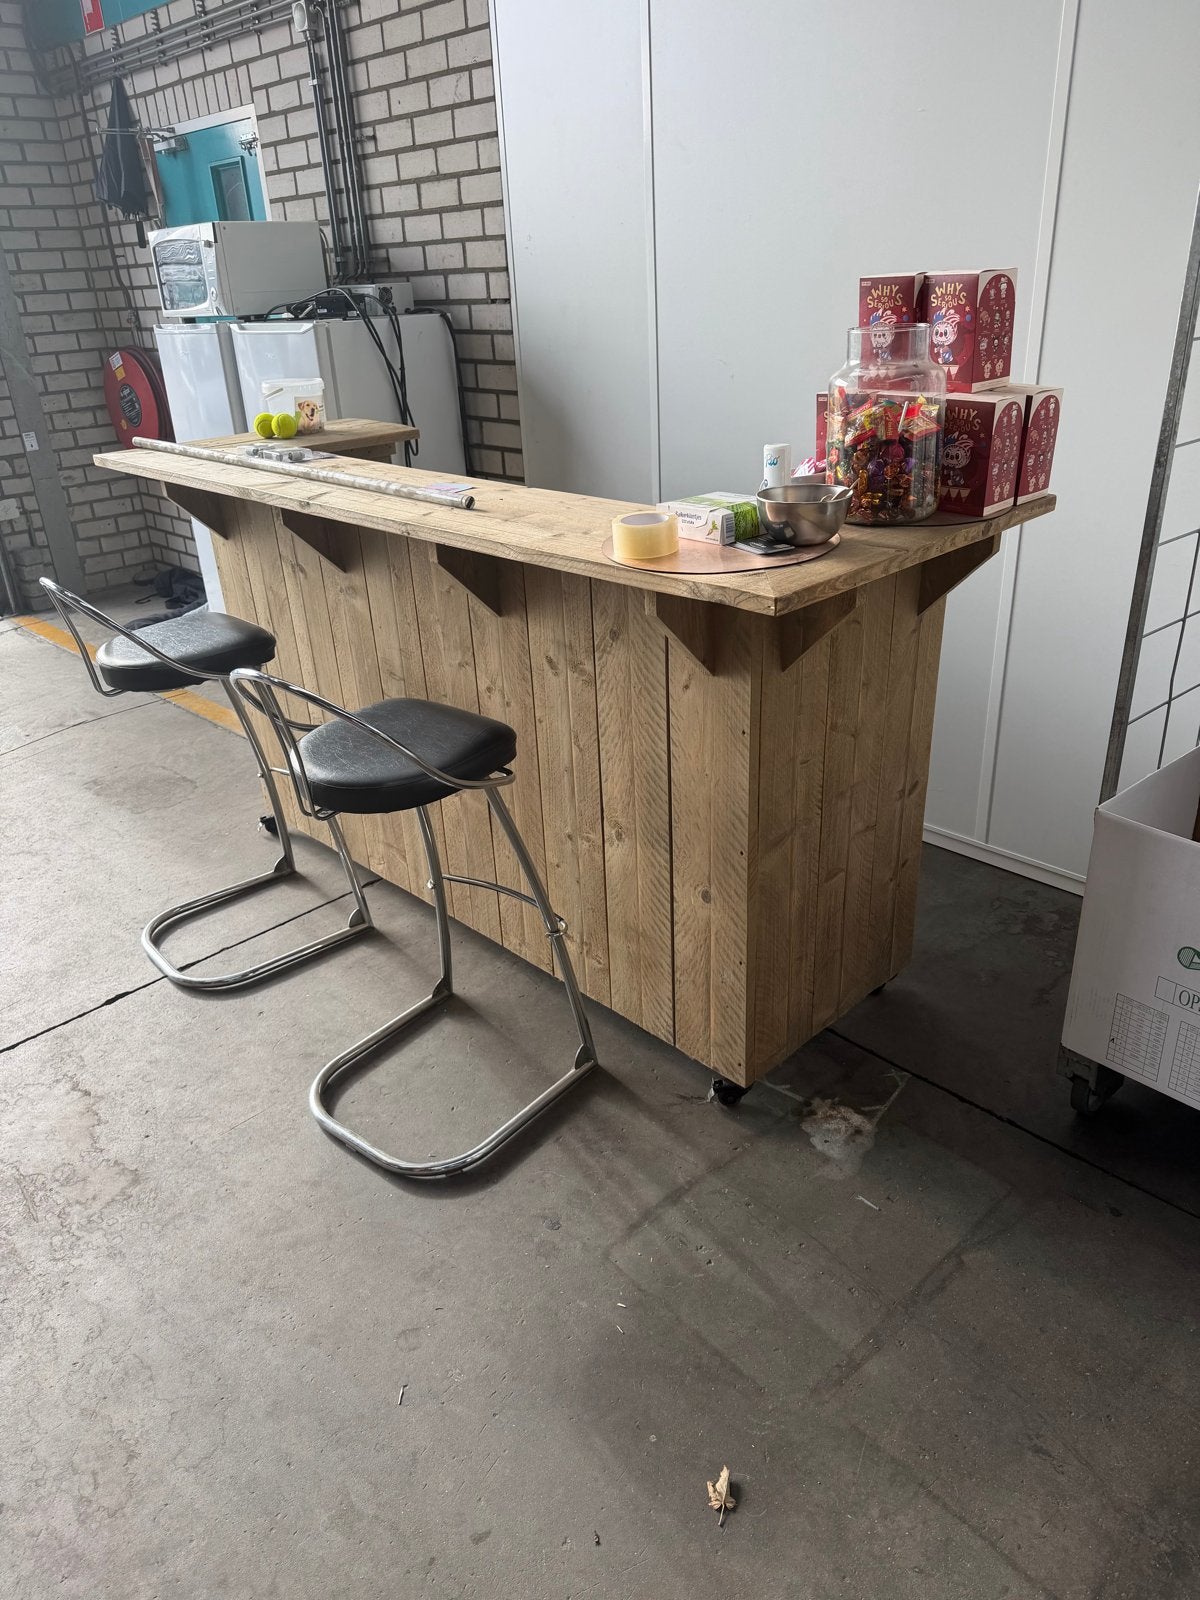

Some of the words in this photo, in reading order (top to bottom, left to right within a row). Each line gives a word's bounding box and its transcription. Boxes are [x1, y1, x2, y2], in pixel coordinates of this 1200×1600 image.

[872, 284, 899, 298] WHY
[935, 282, 963, 297] WHY
[867, 293, 903, 310] SERIOUS
[930, 292, 967, 309] SERIOUS
[947, 406, 978, 421] WHY
[1178, 990, 1200, 1012] OP
